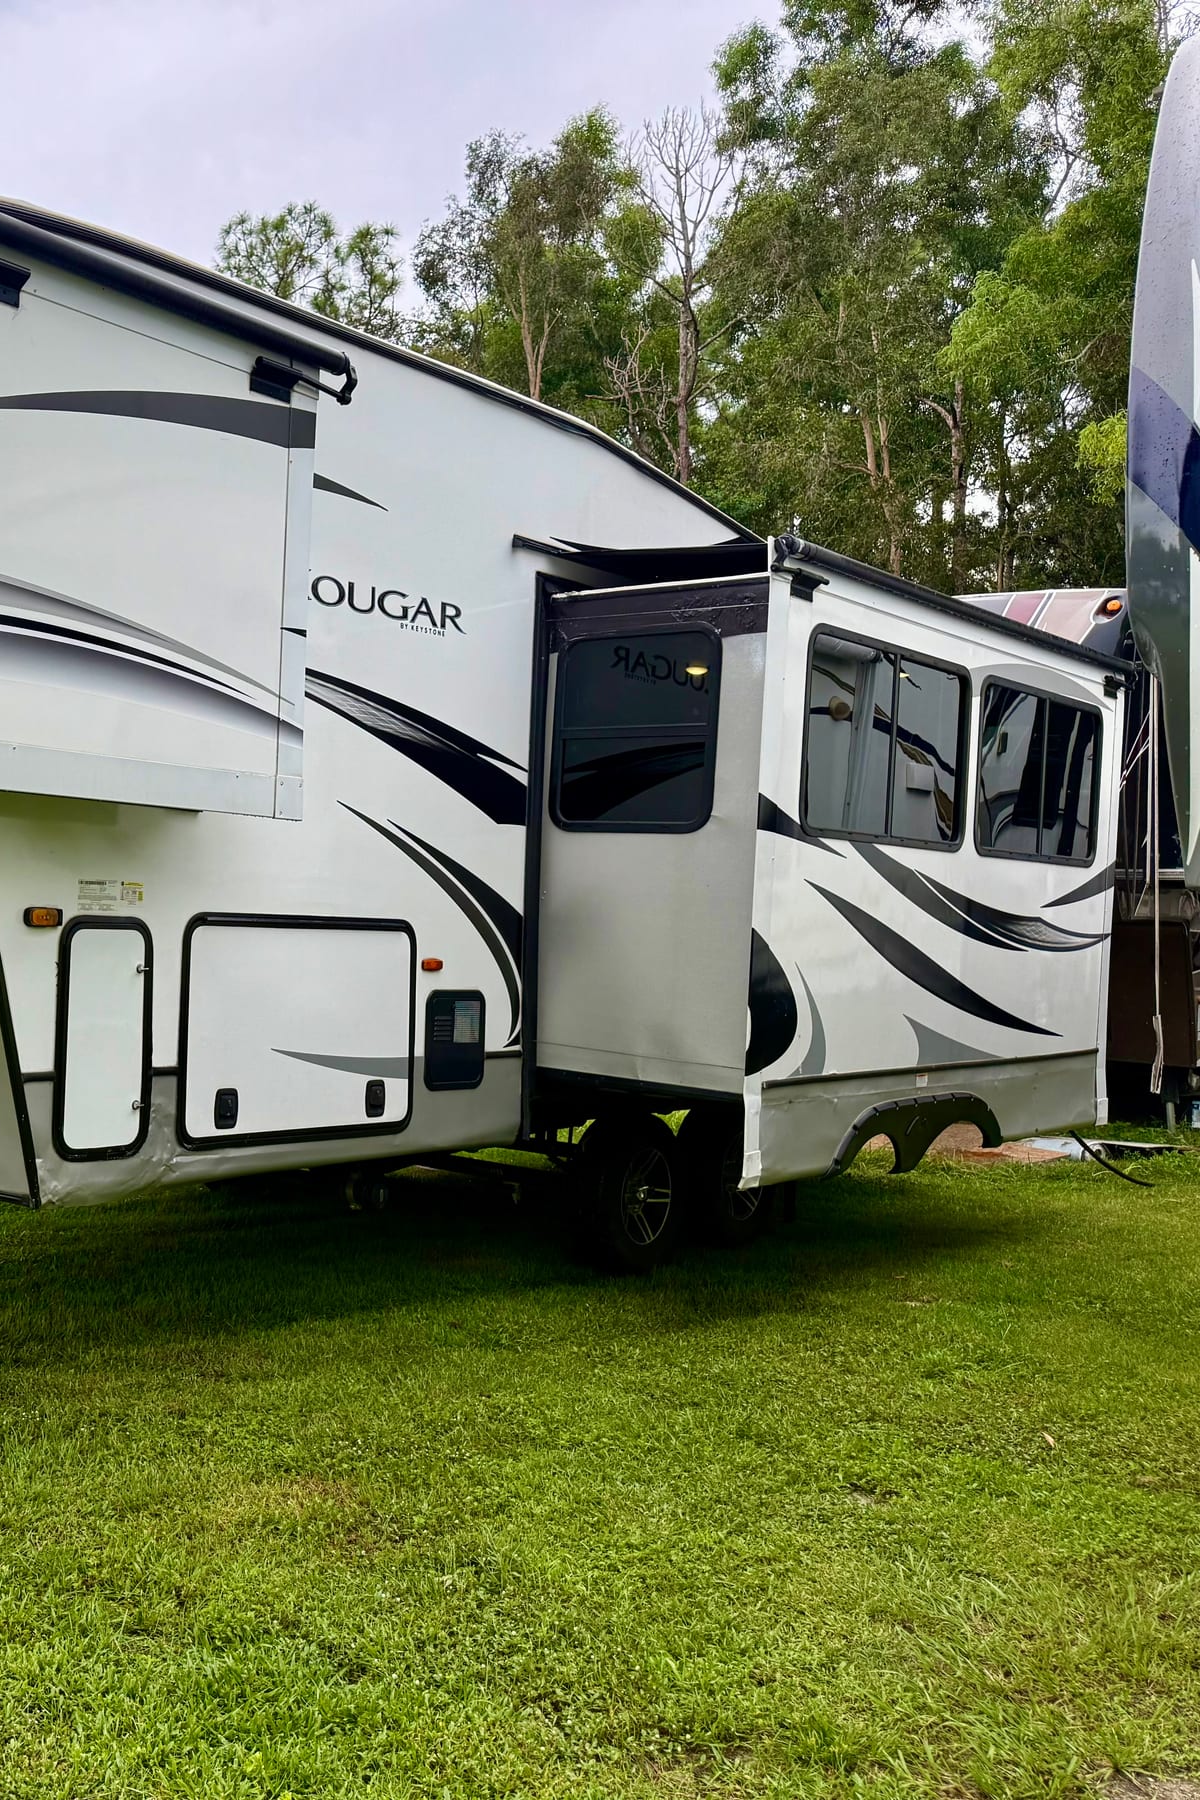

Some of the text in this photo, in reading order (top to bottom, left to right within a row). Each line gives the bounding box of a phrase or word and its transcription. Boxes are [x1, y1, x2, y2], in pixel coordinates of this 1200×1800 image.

[308, 570, 467, 635] OUGAR
[400, 622, 445, 637] BY KEYSTONE
